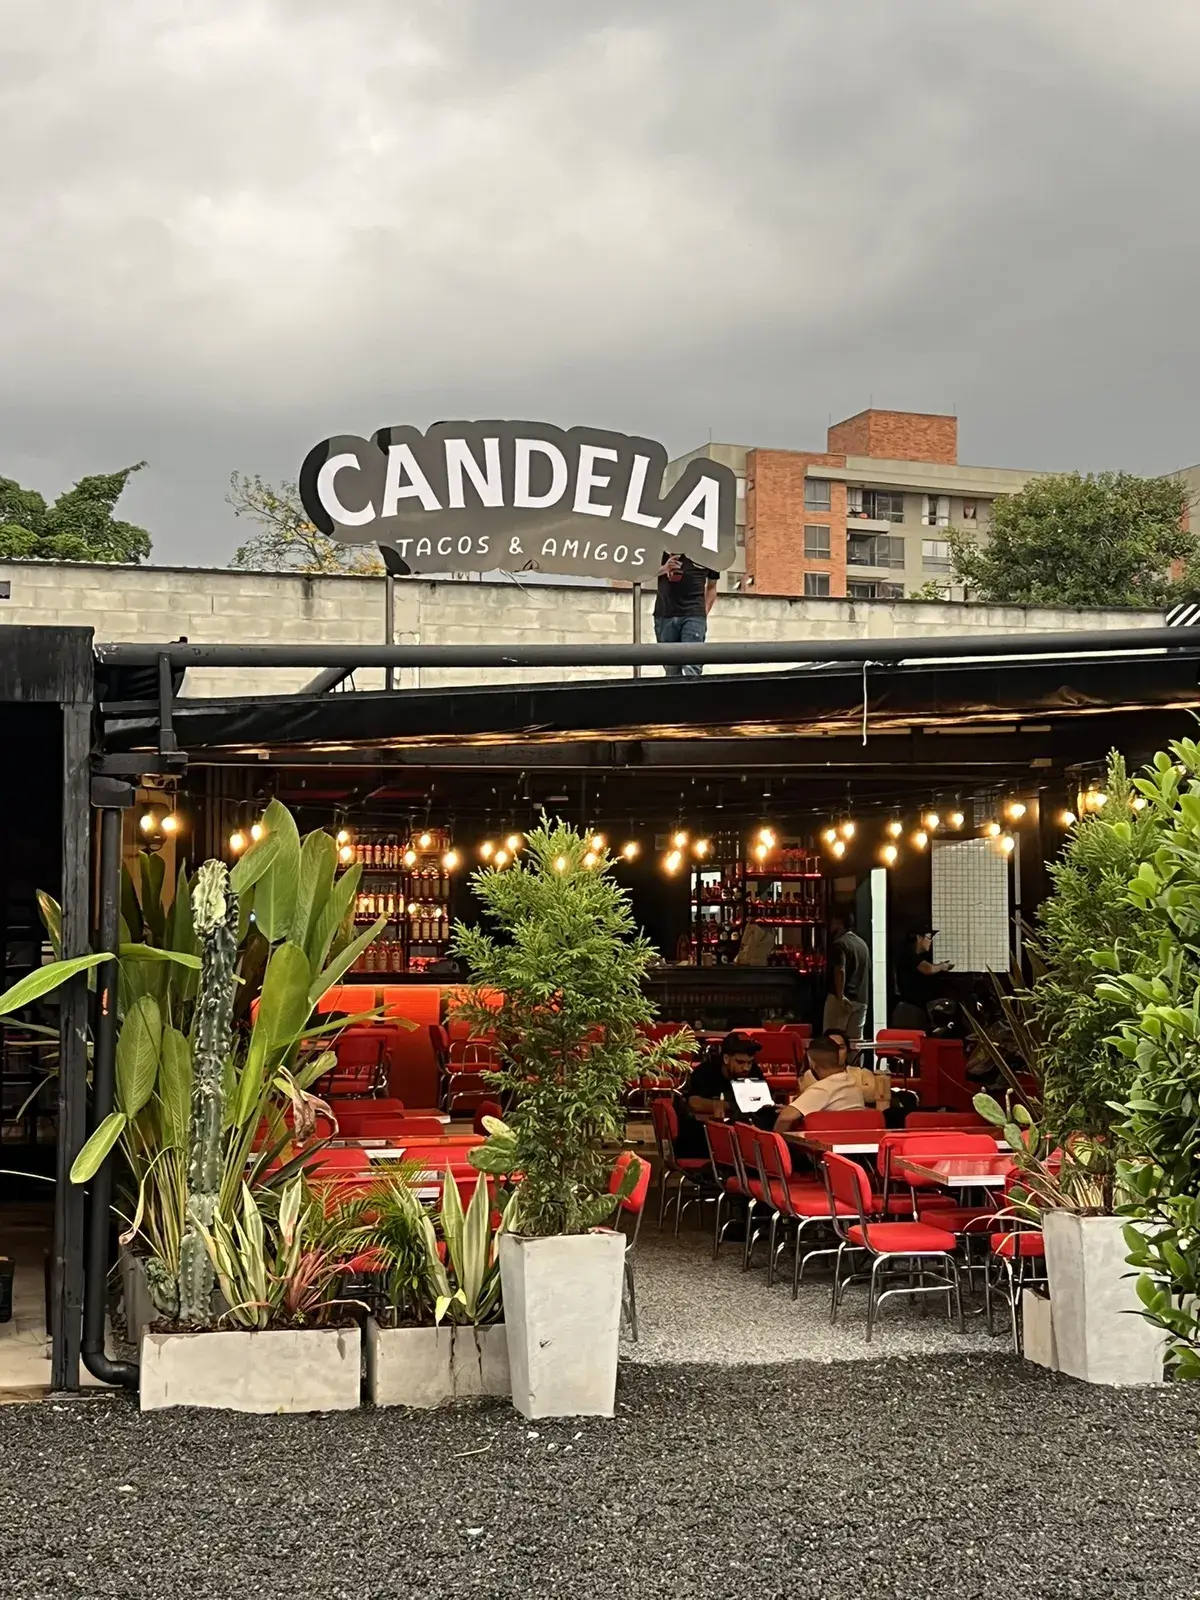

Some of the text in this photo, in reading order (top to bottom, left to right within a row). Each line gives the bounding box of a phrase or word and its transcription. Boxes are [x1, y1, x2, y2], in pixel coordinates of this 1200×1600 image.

[317, 437, 719, 552] CANDELA
[396, 536, 646, 566] TACOS & AMIGOS
